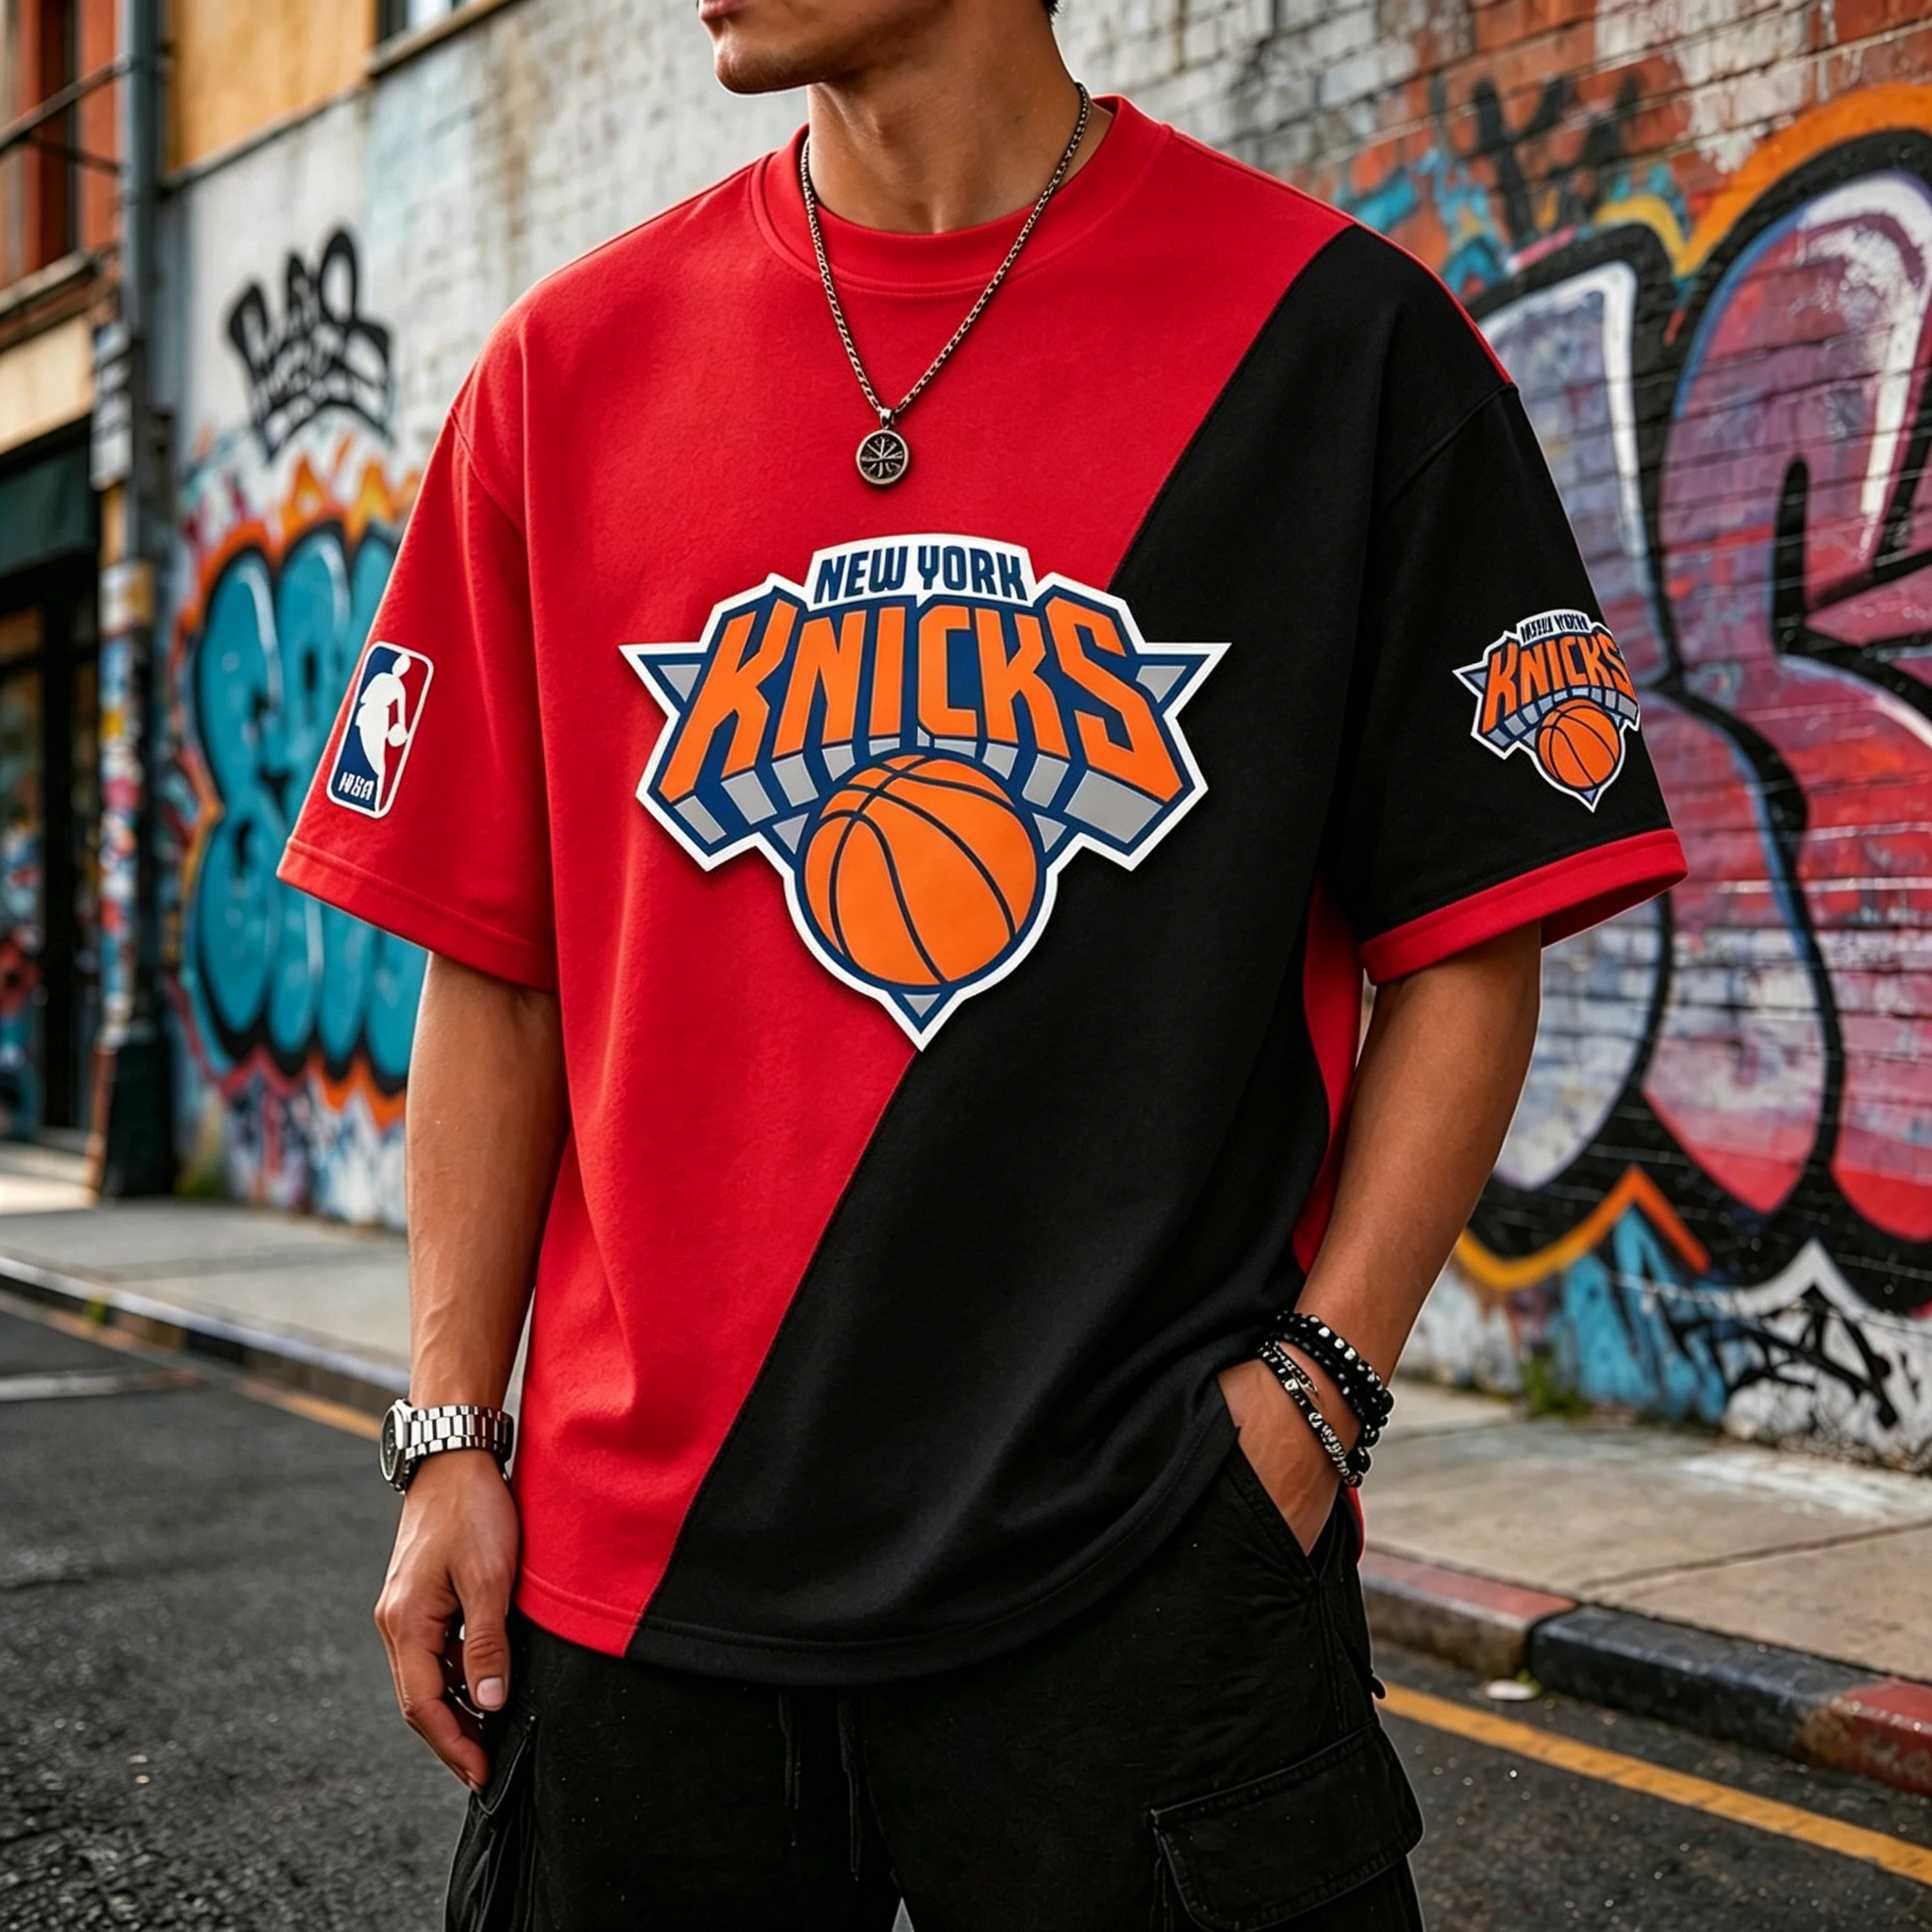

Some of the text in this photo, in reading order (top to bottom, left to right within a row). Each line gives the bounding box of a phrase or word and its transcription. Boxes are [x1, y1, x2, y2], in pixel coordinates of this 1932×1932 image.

[813, 545, 1028, 604] NEW YORK
[658, 595, 1185, 806] KNICKS
[1482, 632, 1638, 733] KNICKS
